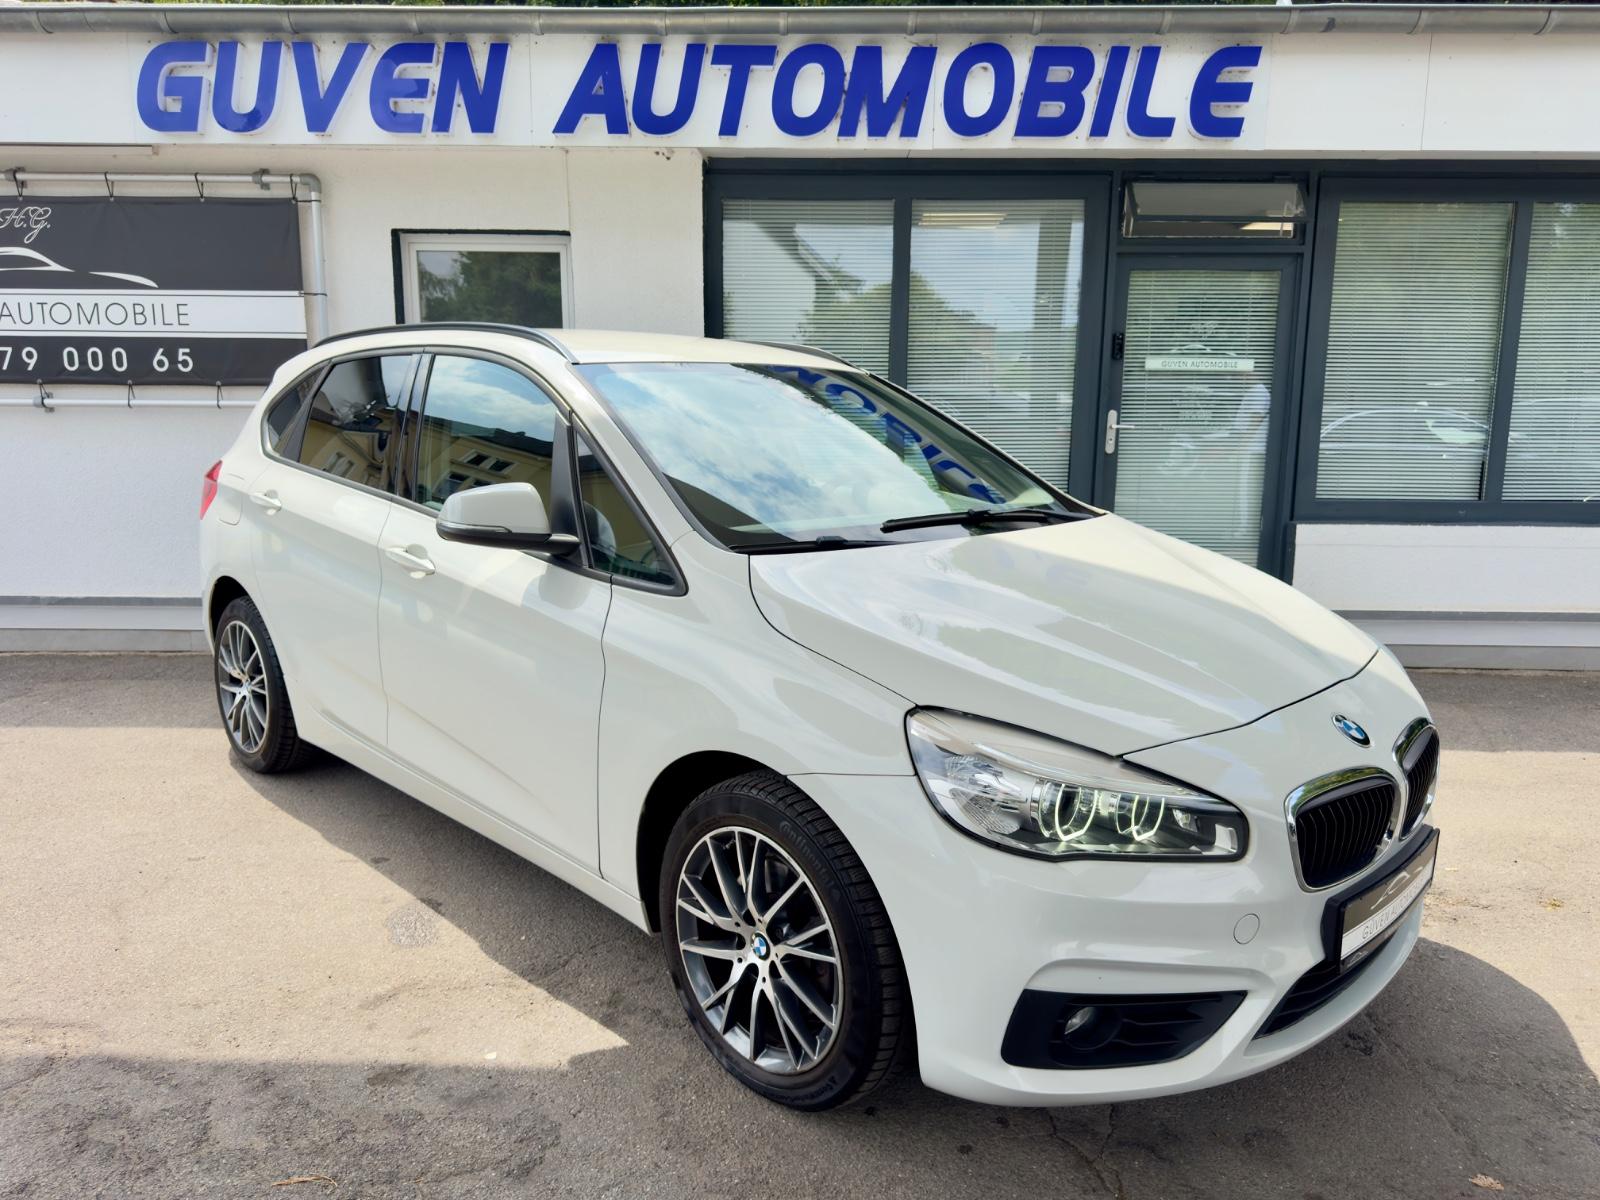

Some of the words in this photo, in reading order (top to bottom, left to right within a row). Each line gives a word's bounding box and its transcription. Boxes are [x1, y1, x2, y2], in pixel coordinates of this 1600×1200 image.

[136, 41, 509, 134] GUVEN
[552, 43, 1262, 137] AUTOMOBILE
[0, 301, 190, 327] AUTOMOBILE
[0, 346, 39, 372] 79
[62, 346, 128, 373] 000
[152, 347, 194, 373] 65
[1190, 360, 1239, 370] AUTOMOBILE
